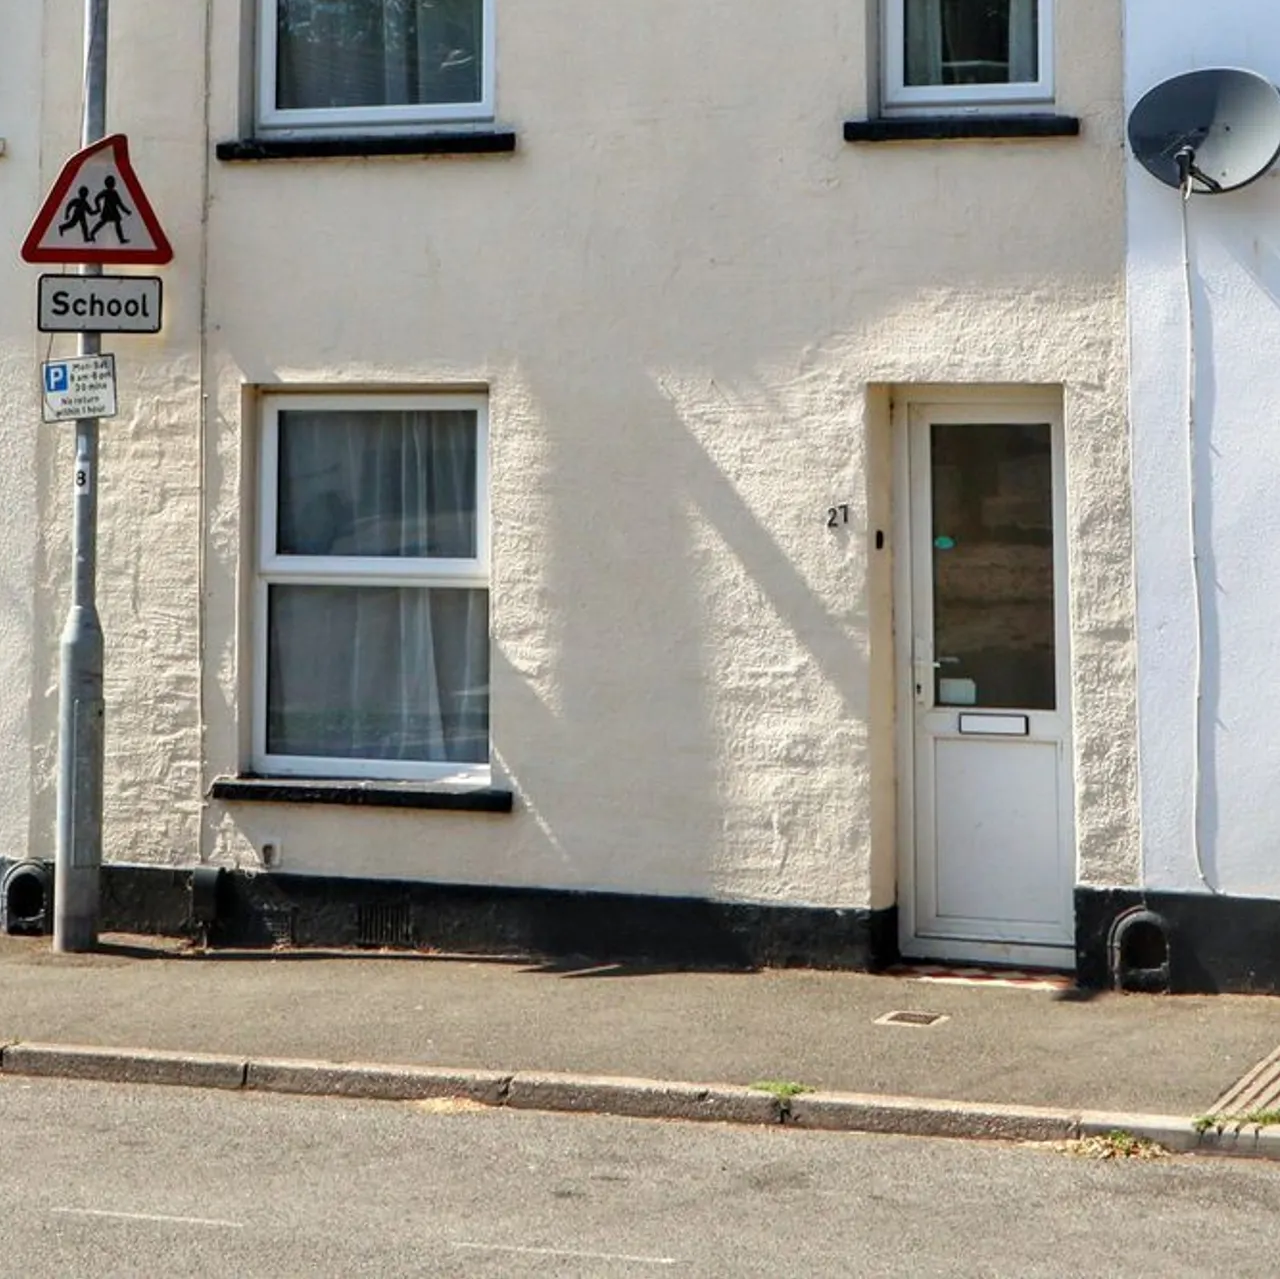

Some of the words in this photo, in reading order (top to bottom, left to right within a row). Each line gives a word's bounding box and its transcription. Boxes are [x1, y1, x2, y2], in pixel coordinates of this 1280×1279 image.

[51, 290, 150, 318] School
[49, 367, 64, 390] P
[827, 504, 849, 529] 27
